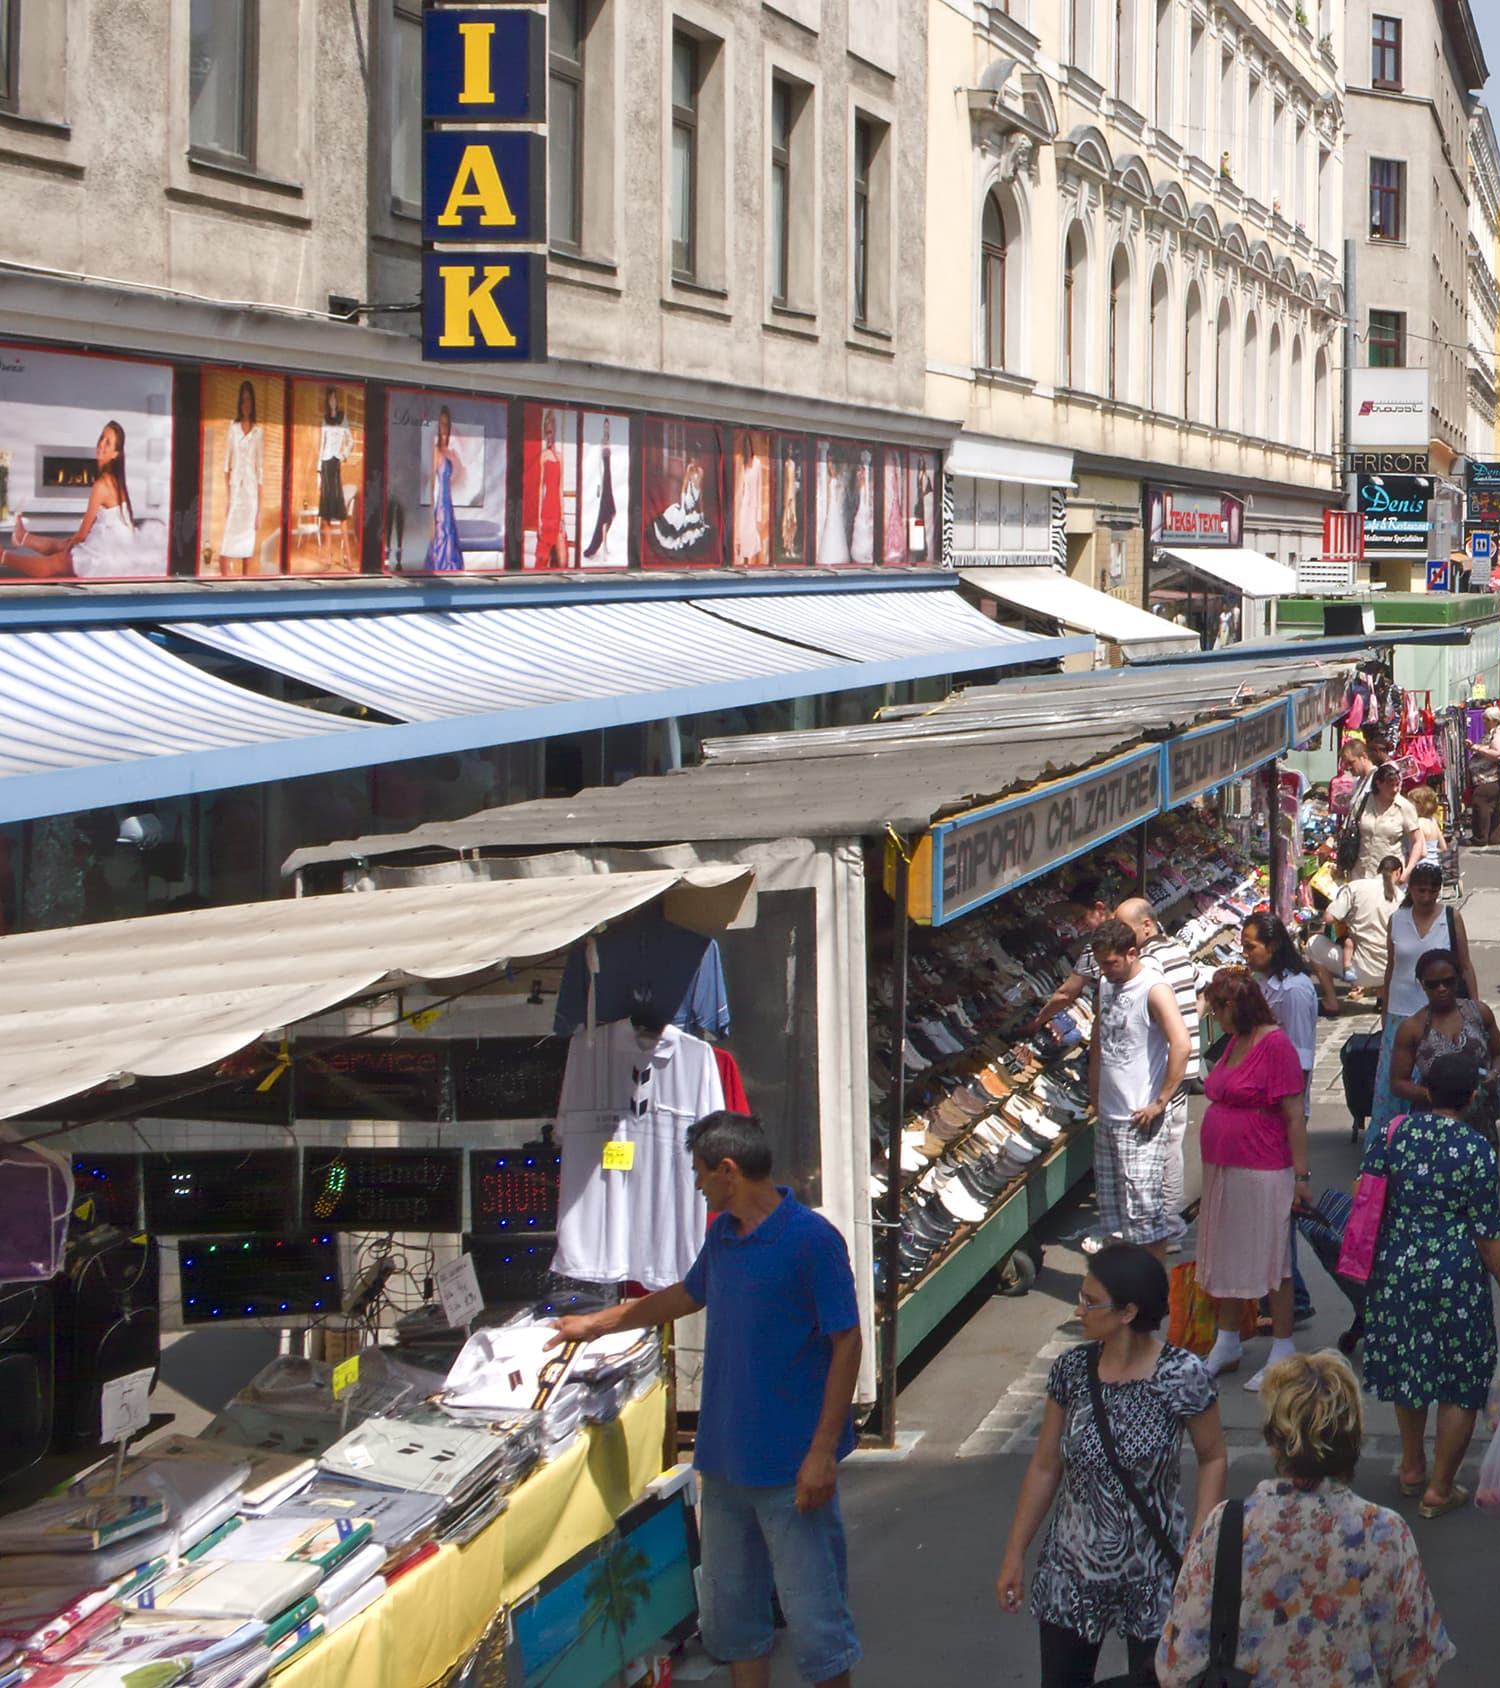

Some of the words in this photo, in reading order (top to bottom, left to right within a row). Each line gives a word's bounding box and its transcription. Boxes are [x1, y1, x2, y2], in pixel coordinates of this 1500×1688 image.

[1361, 484, 1424, 513] Denis
[943, 811, 1035, 898] EMPORIO
[1047, 765, 1149, 850] CALZATURE
